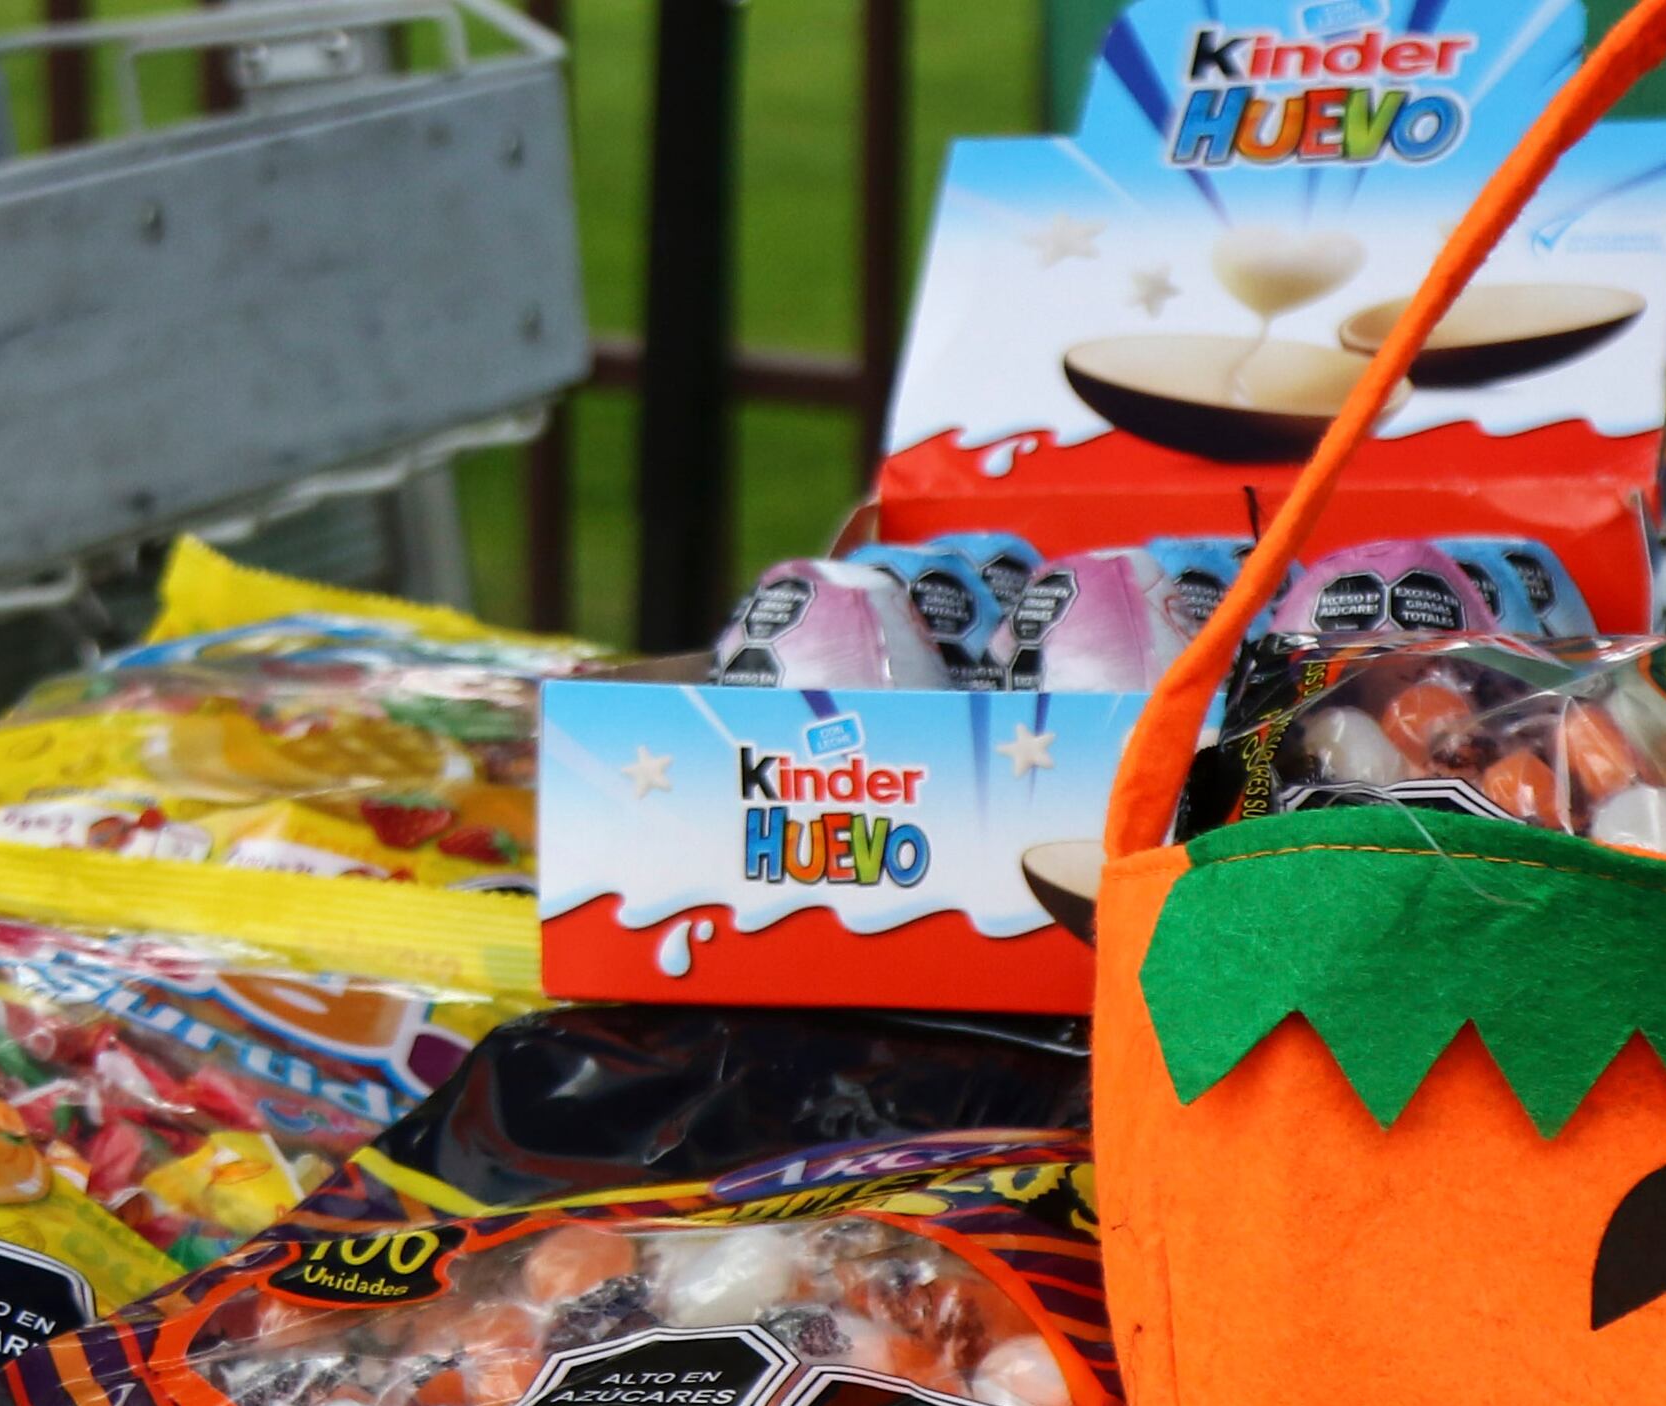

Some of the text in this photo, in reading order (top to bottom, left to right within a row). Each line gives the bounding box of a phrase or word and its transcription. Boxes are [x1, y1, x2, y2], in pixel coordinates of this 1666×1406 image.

[1190, 30, 1471, 80] Kinder
[1172, 86, 1465, 164] HUEVO
[741, 747, 925, 804] Kinder
[745, 807, 931, 888] HUEVO
[303, 1264, 409, 1296] Unidades
[16, 1312, 57, 1335] EN
[550, 1387, 737, 1405] AZÚCARES
[601, 1370, 722, 1384] ALTO EN
